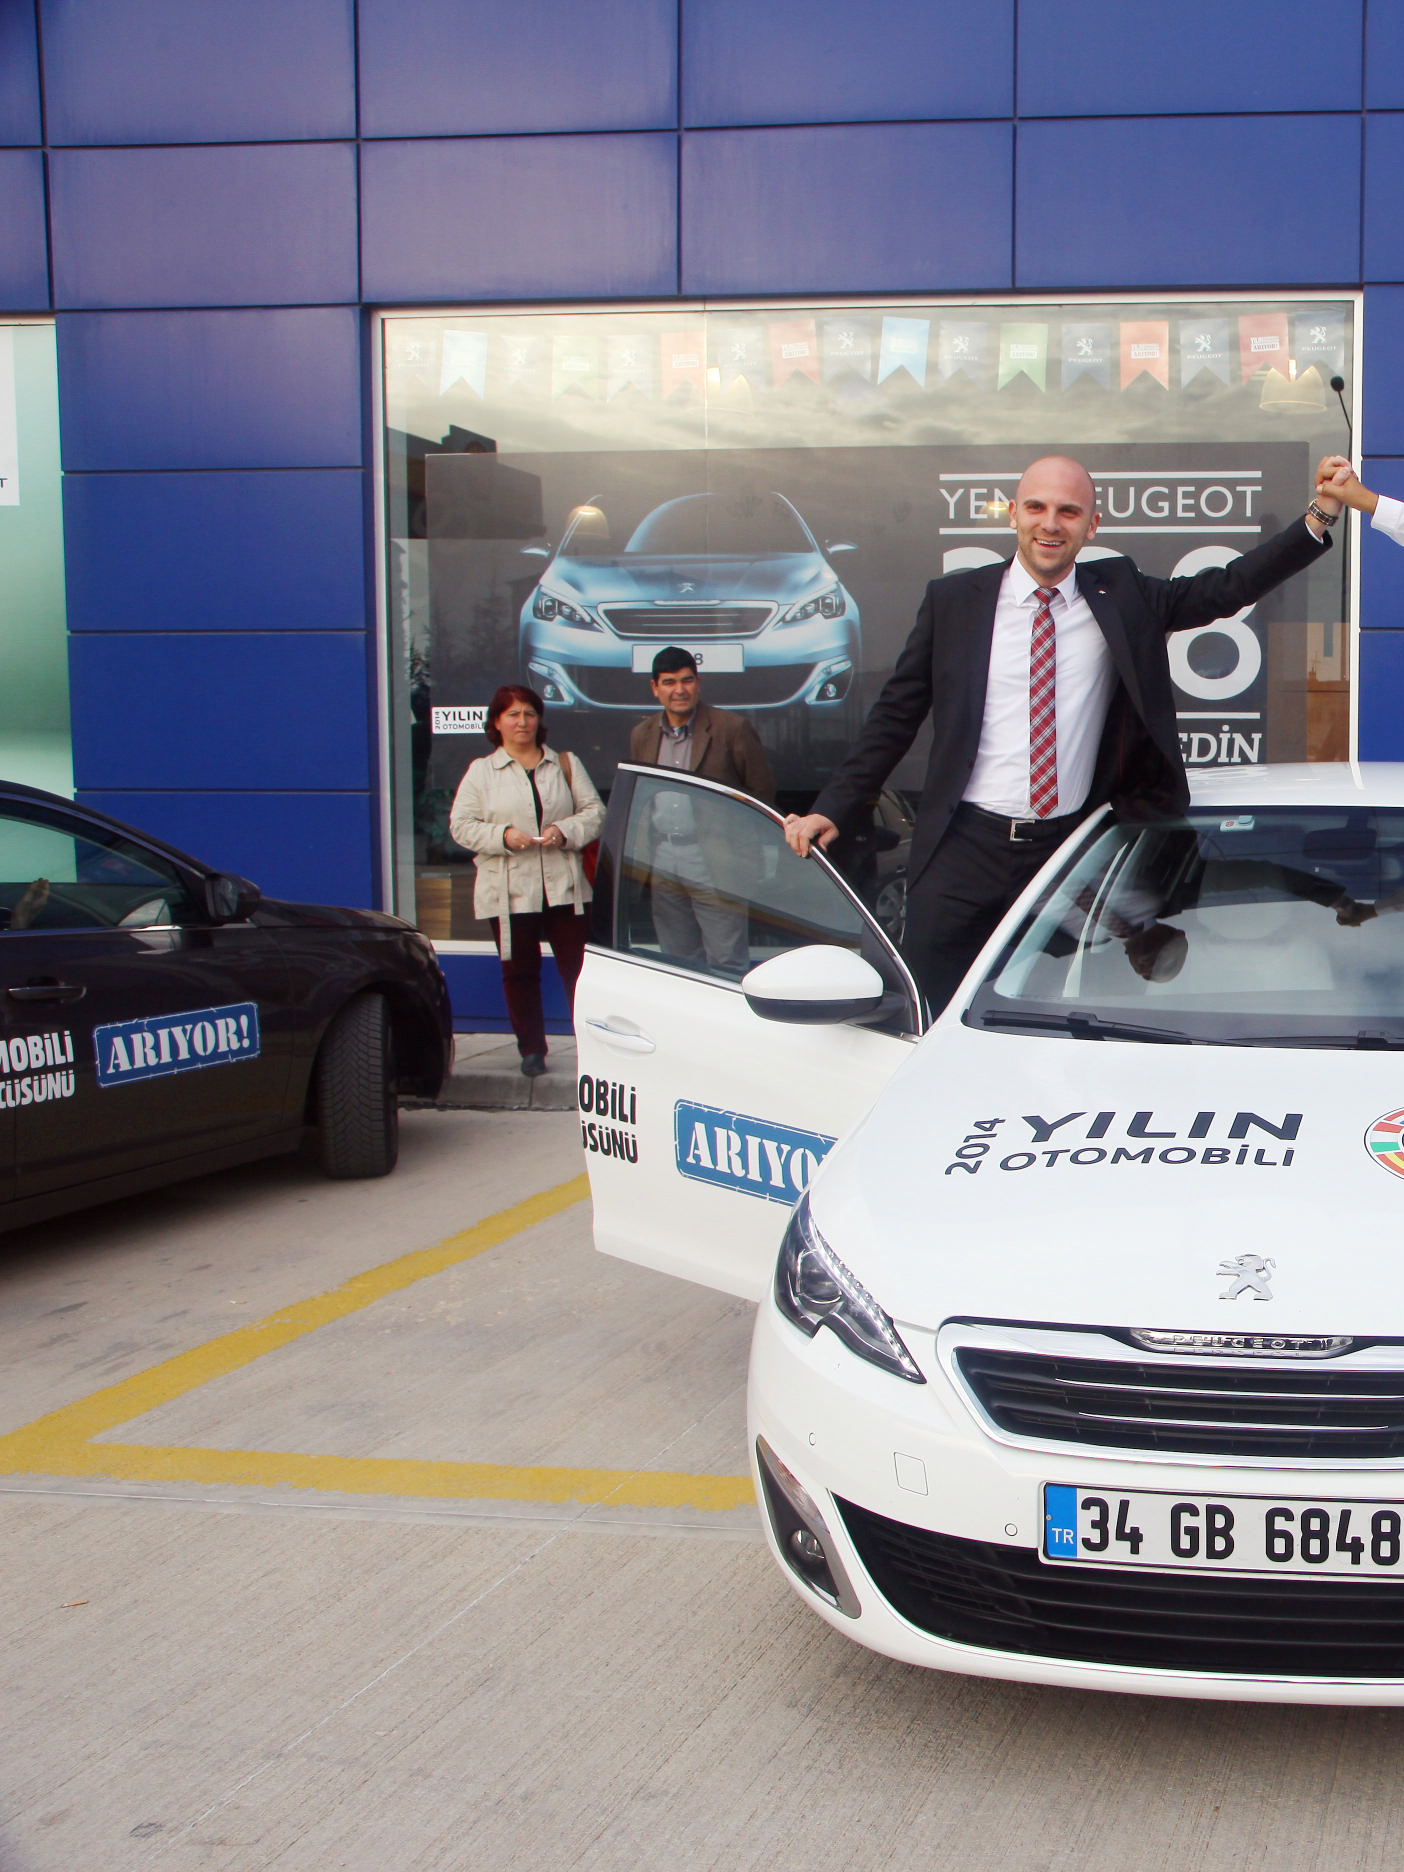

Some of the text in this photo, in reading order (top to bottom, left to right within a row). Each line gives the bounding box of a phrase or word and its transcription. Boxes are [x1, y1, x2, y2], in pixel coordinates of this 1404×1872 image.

[442, 711, 483, 721] YILIN
[106, 1014, 250, 1074] ARIYOR!
[945, 1112, 1303, 1175] 2014 YILIN
[999, 1144, 1296, 1171] OTOMOBİLİ
[1173, 1334, 1309, 1350] PEUGEOT
[1051, 1497, 1401, 1566] TR 34 GB 6848
